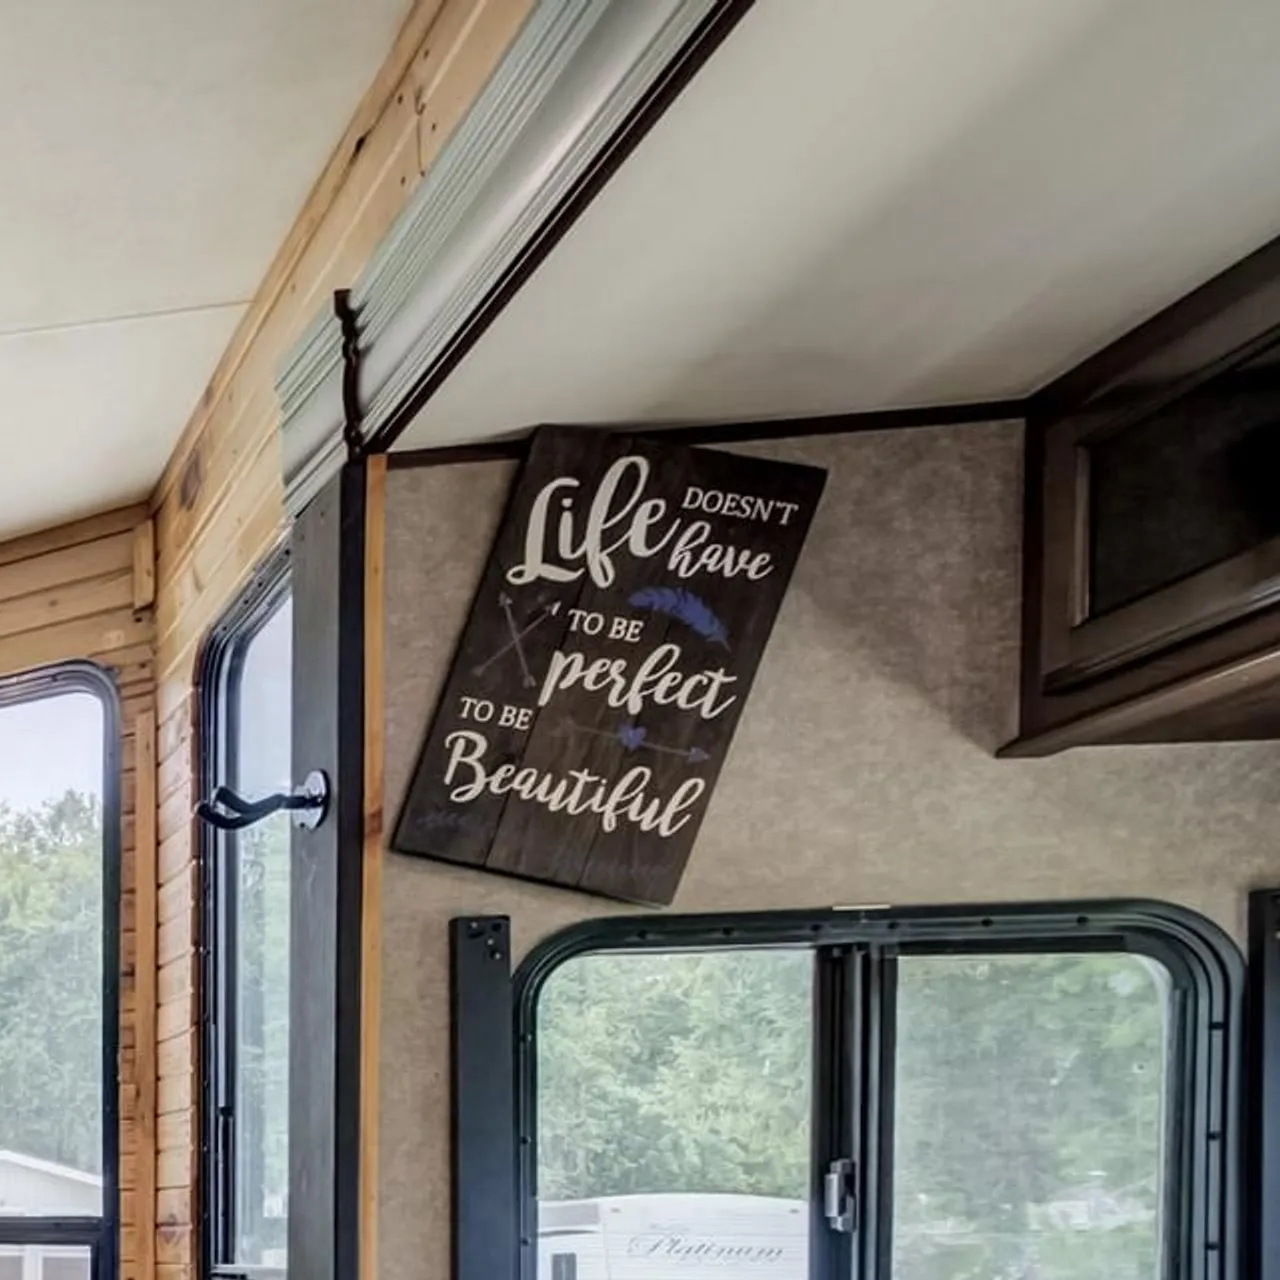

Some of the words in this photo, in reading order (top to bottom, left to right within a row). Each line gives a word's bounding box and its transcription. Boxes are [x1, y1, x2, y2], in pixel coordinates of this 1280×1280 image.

[506, 456, 682, 588] Life
[682, 486, 799, 525] DOESN'T
[668, 518, 775, 580] have
[567, 608, 605, 636] TO
[608, 616, 644, 643] BE
[538, 643, 738, 719] perfect
[460, 696, 495, 722] TO
[497, 706, 533, 731] BE
[443, 730, 706, 838] Beautiful
